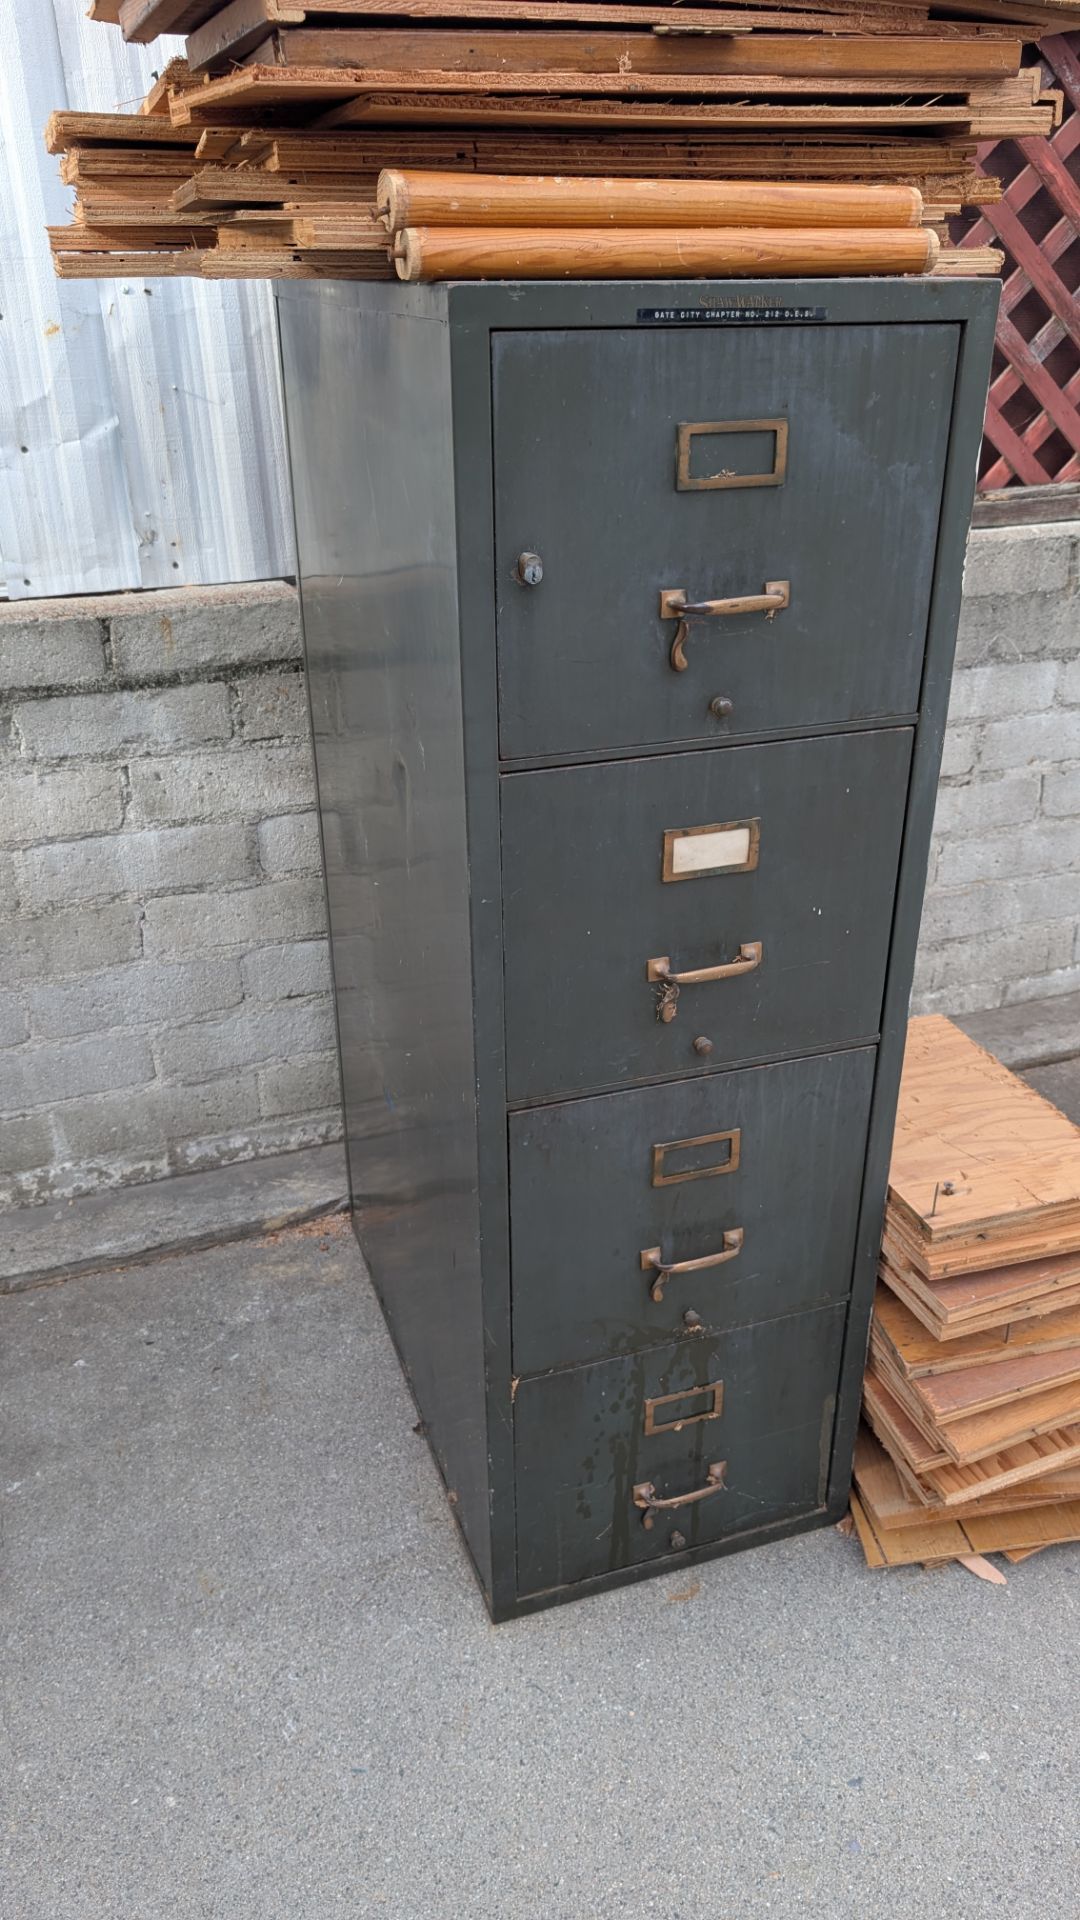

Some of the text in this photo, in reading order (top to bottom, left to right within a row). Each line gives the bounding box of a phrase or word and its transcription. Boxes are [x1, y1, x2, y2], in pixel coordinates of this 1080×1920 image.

[654, 311, 675, 319] GATE
[681, 311, 700, 319] CITY
[705, 310, 740, 319] CHAPTER
[745, 310, 759, 318] NO.
[765, 310, 779, 318] 212
